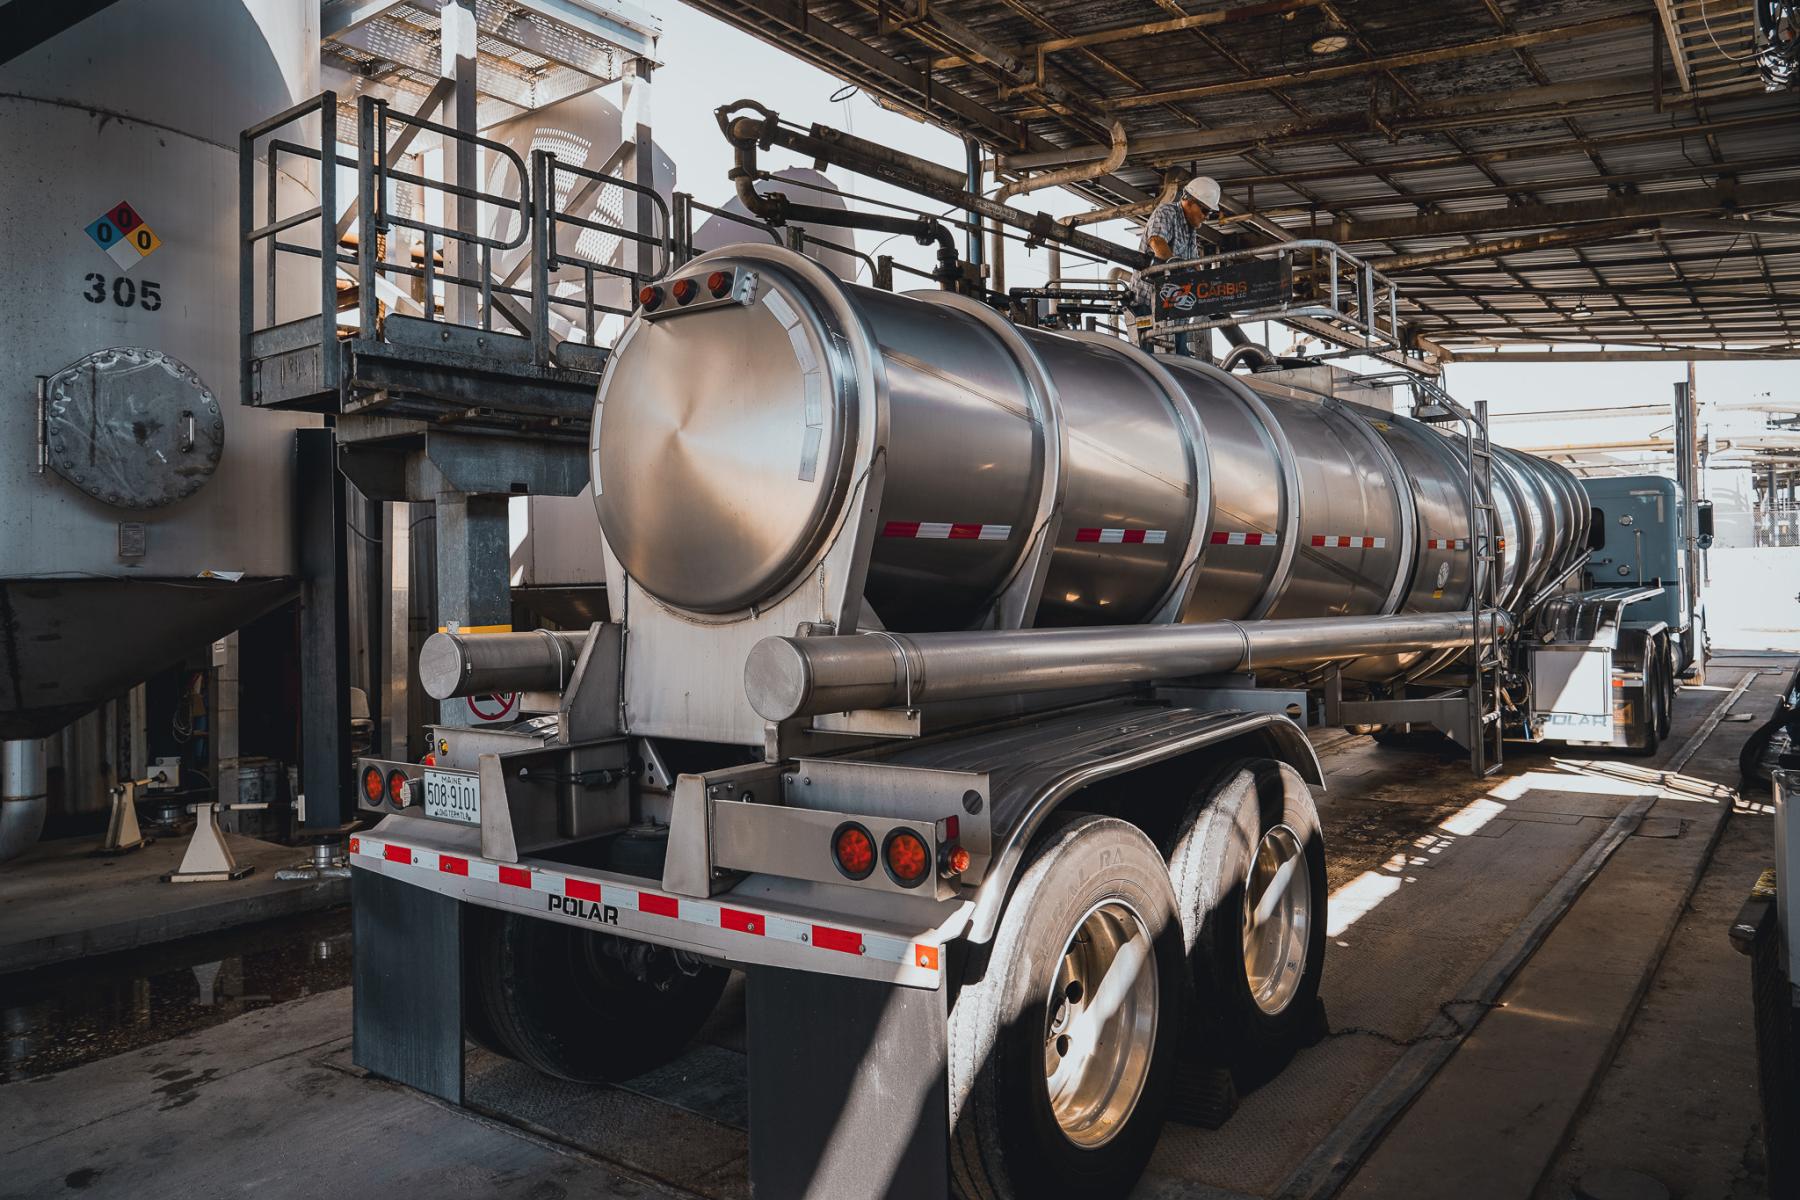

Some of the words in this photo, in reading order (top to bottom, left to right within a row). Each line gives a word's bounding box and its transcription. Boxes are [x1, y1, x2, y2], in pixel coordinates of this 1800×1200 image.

[117, 208, 132, 228] 0
[97, 223, 112, 243] 0
[137, 230, 151, 250] 0
[83, 273, 162, 312] 305
[1196, 281, 1248, 299] CARBIS
[1535, 714, 1607, 727] POLAR
[441, 776, 462, 786] MAINE
[548, 893, 619, 926] POLAR
